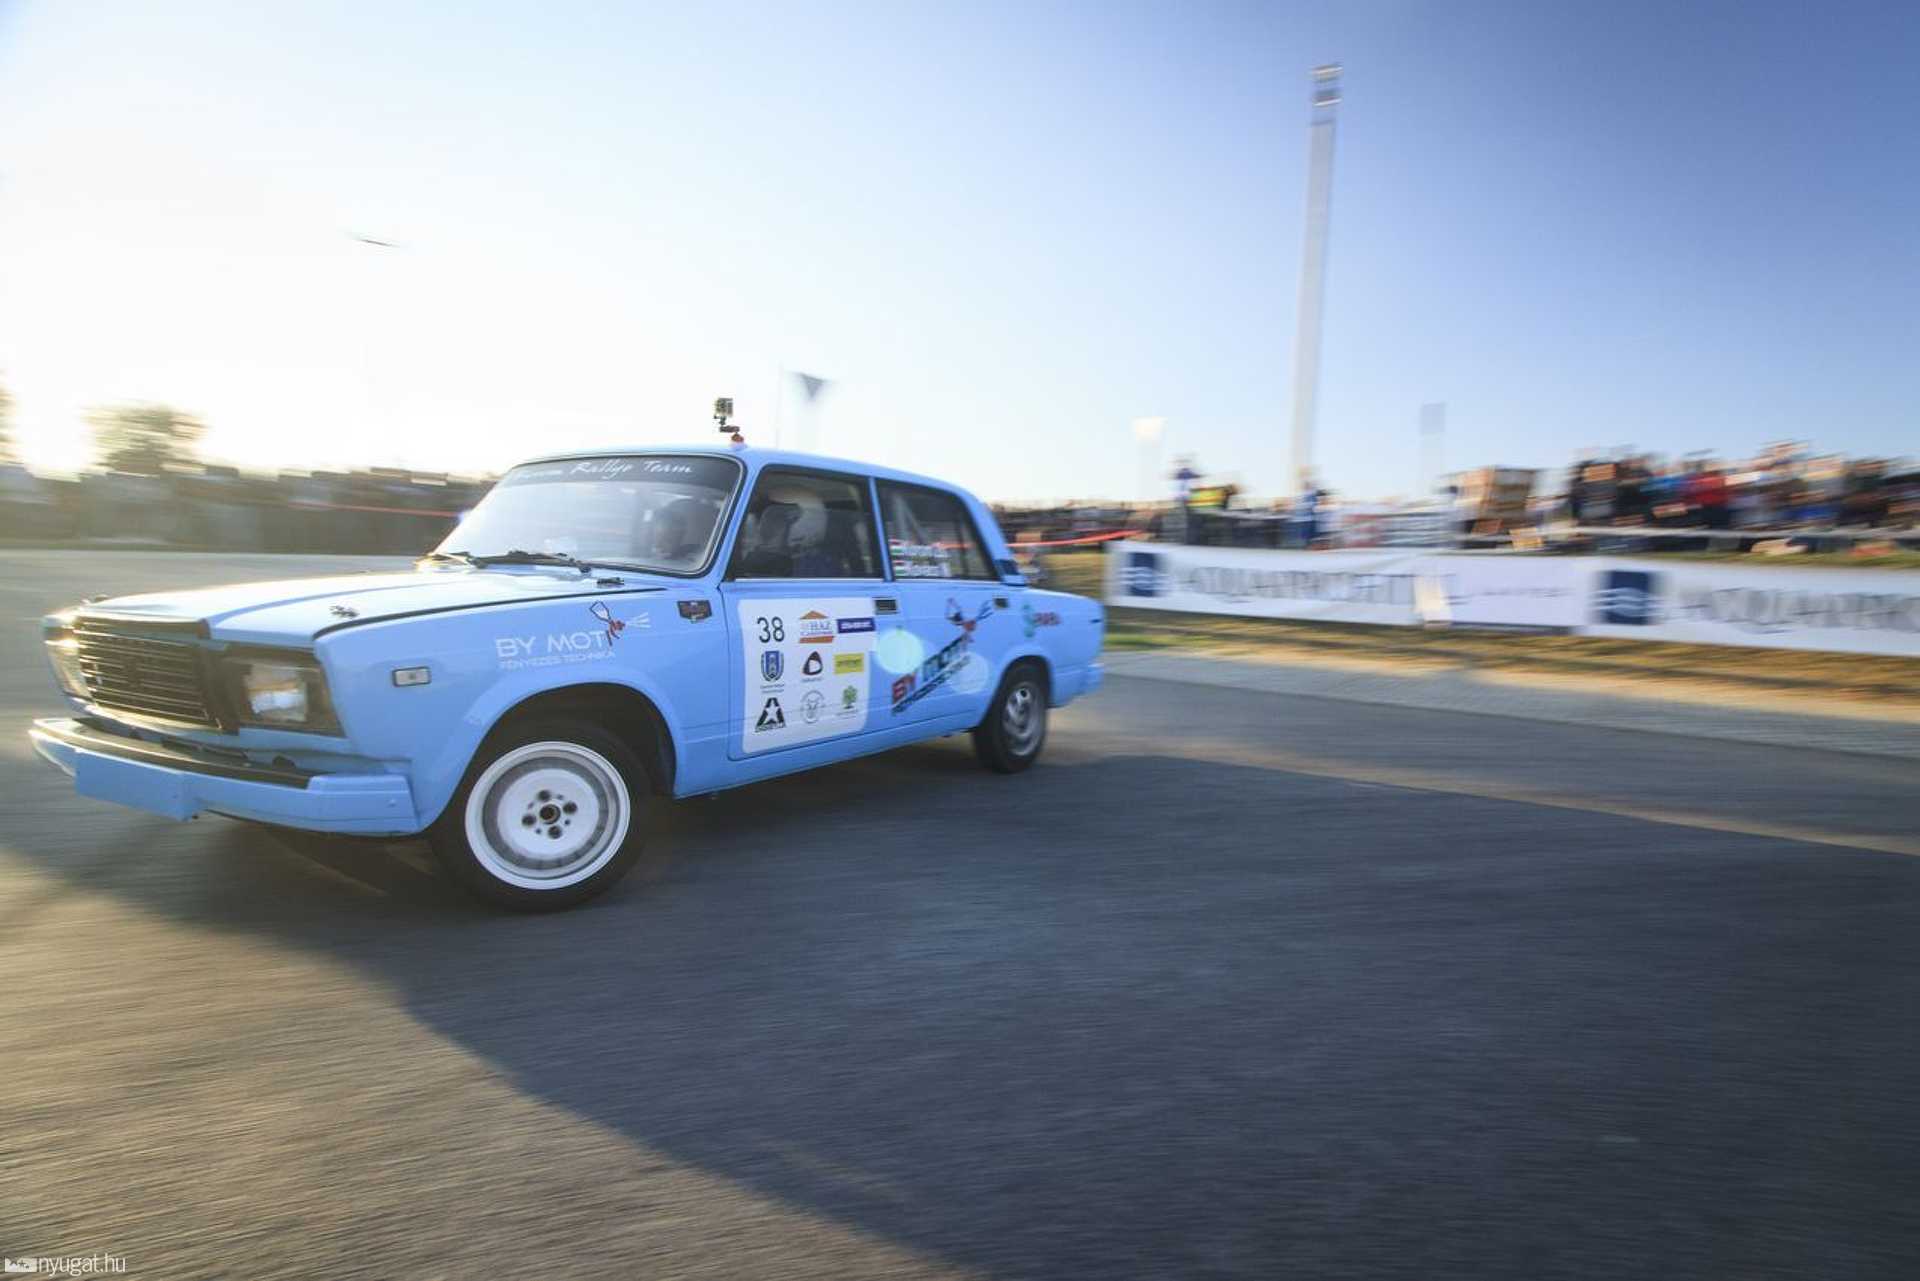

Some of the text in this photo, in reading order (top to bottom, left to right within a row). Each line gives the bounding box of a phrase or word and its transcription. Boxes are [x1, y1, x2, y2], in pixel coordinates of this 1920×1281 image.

[643, 460, 693, 473] Team
[757, 617, 785, 643] 38
[495, 636, 537, 657] BY
